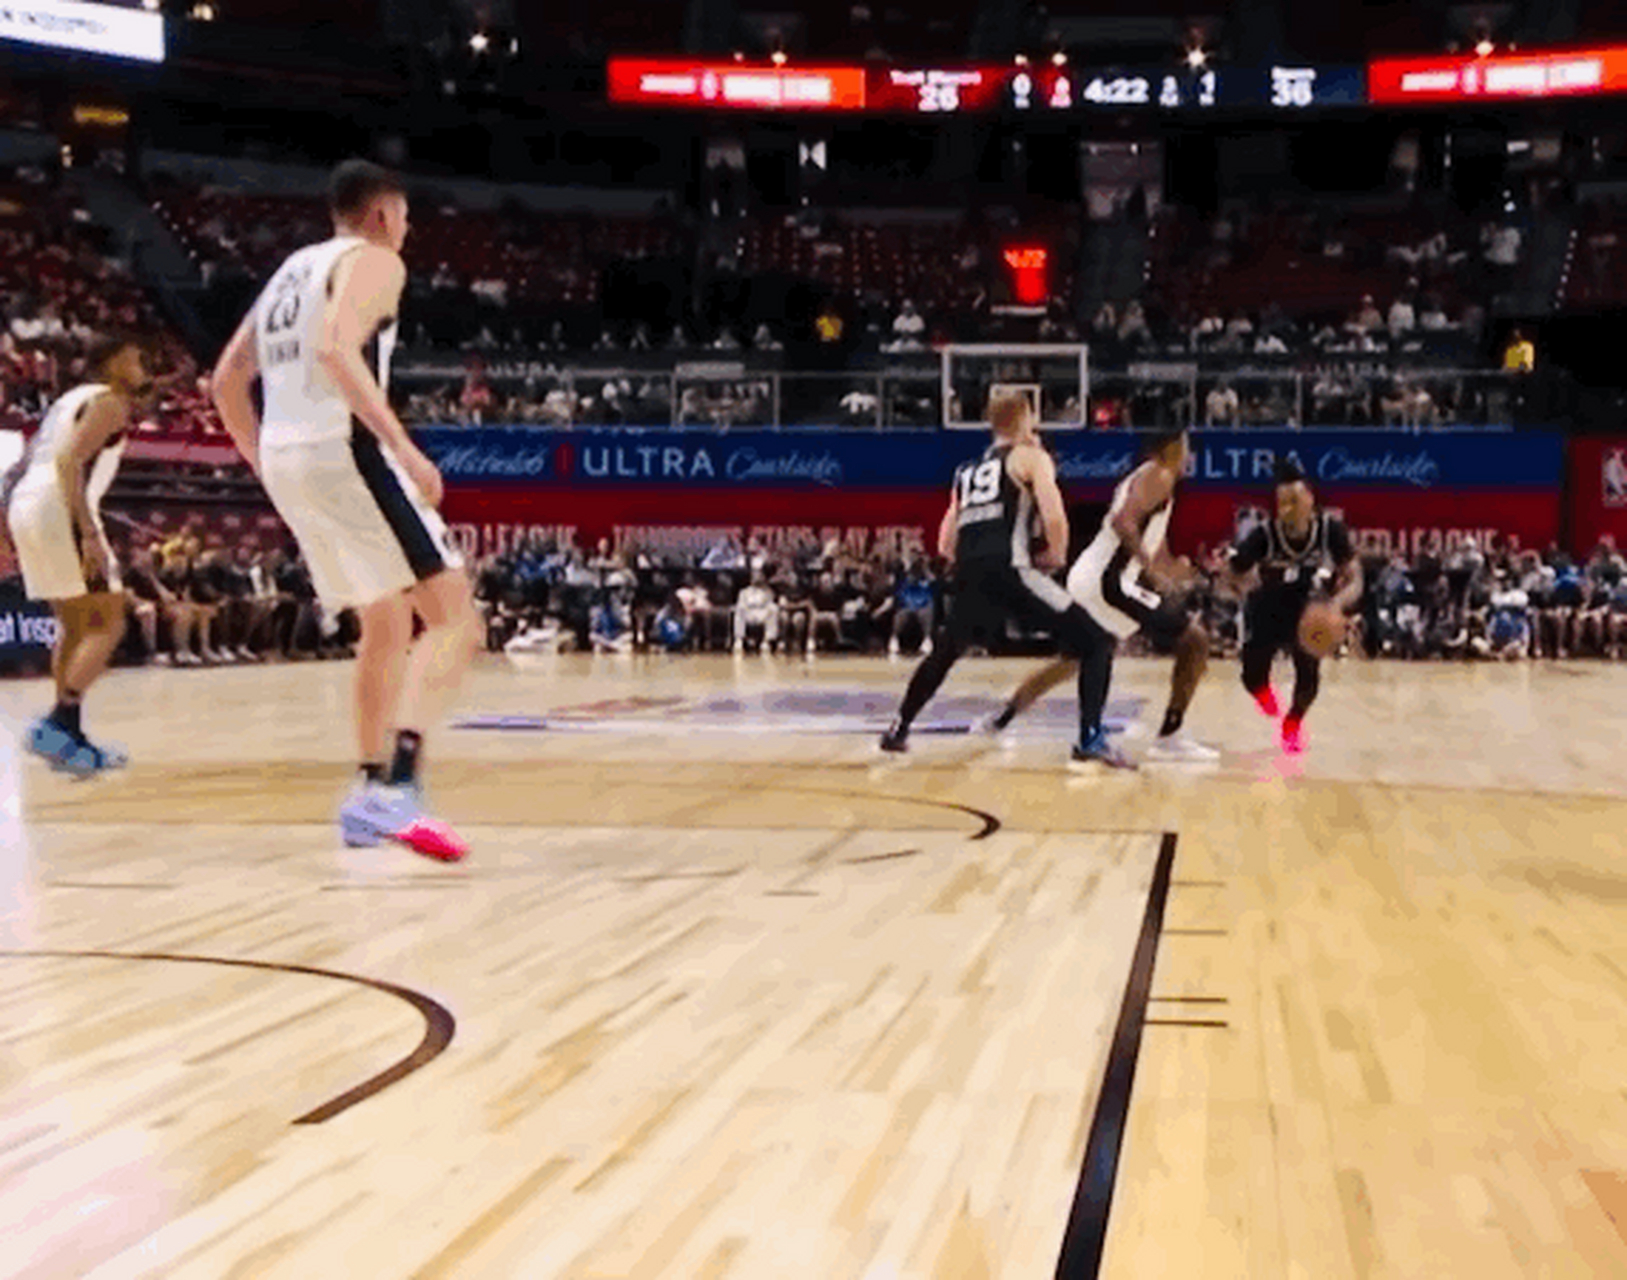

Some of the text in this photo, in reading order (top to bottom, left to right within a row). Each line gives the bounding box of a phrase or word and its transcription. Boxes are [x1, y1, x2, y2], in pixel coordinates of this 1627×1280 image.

[1084, 77, 1149, 103] 4:22
[582, 447, 717, 477] ULTRA
[959, 459, 1001, 508] 19
